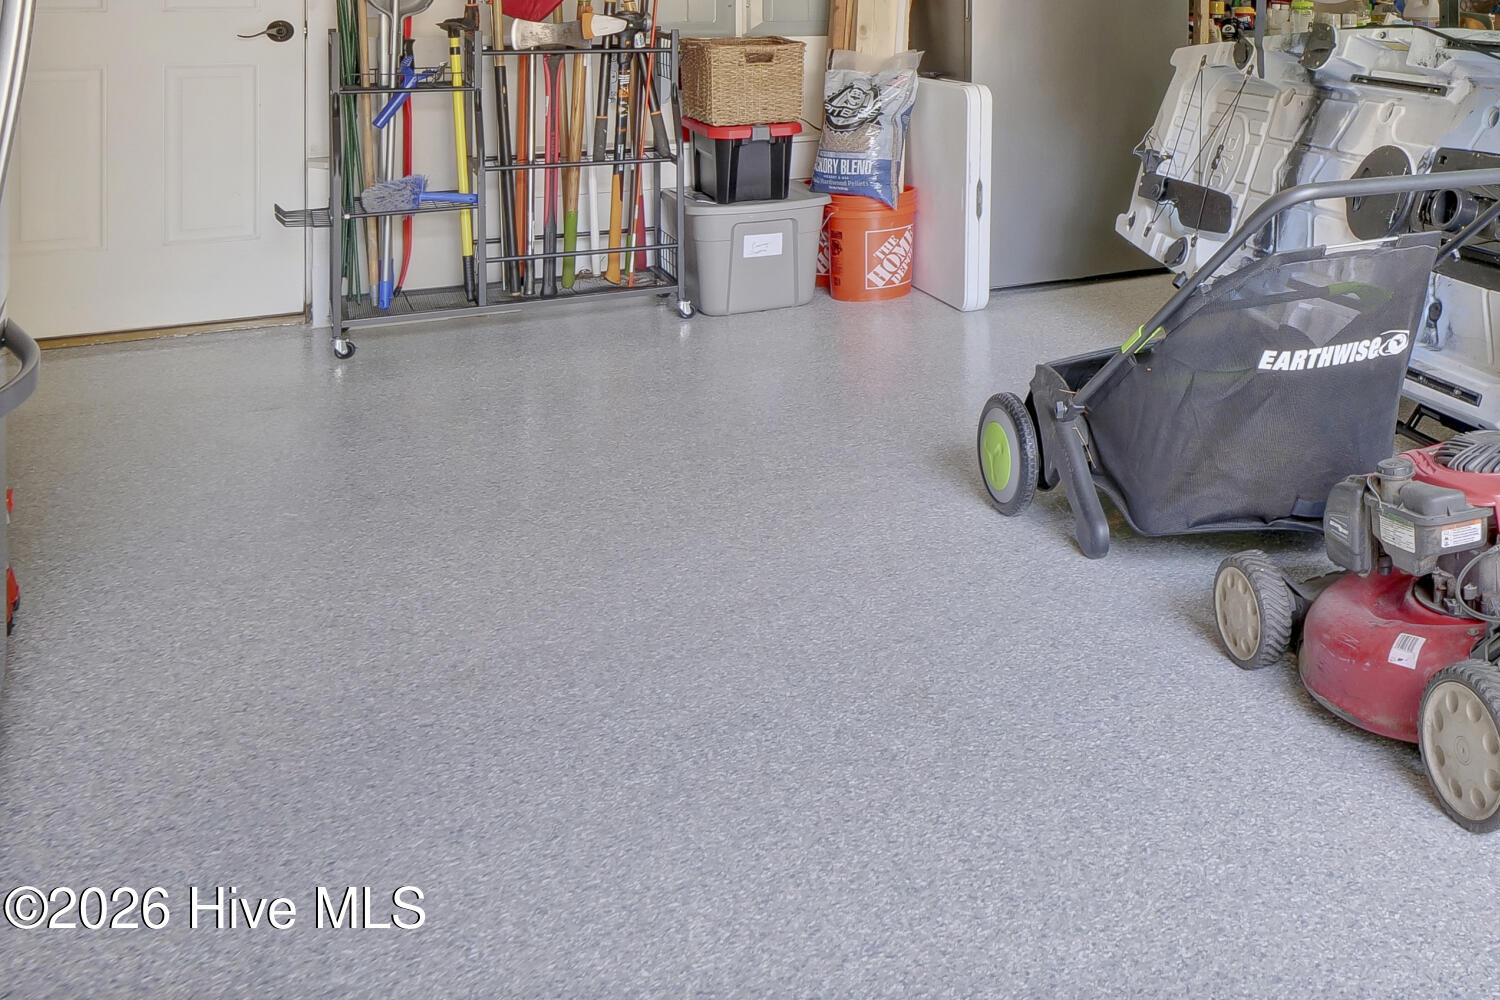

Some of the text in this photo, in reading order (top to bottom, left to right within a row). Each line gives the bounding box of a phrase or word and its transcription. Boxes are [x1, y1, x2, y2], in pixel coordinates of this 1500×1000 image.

[815, 158, 873, 175] CKORY BLEND
[873, 234, 900, 260] THE
